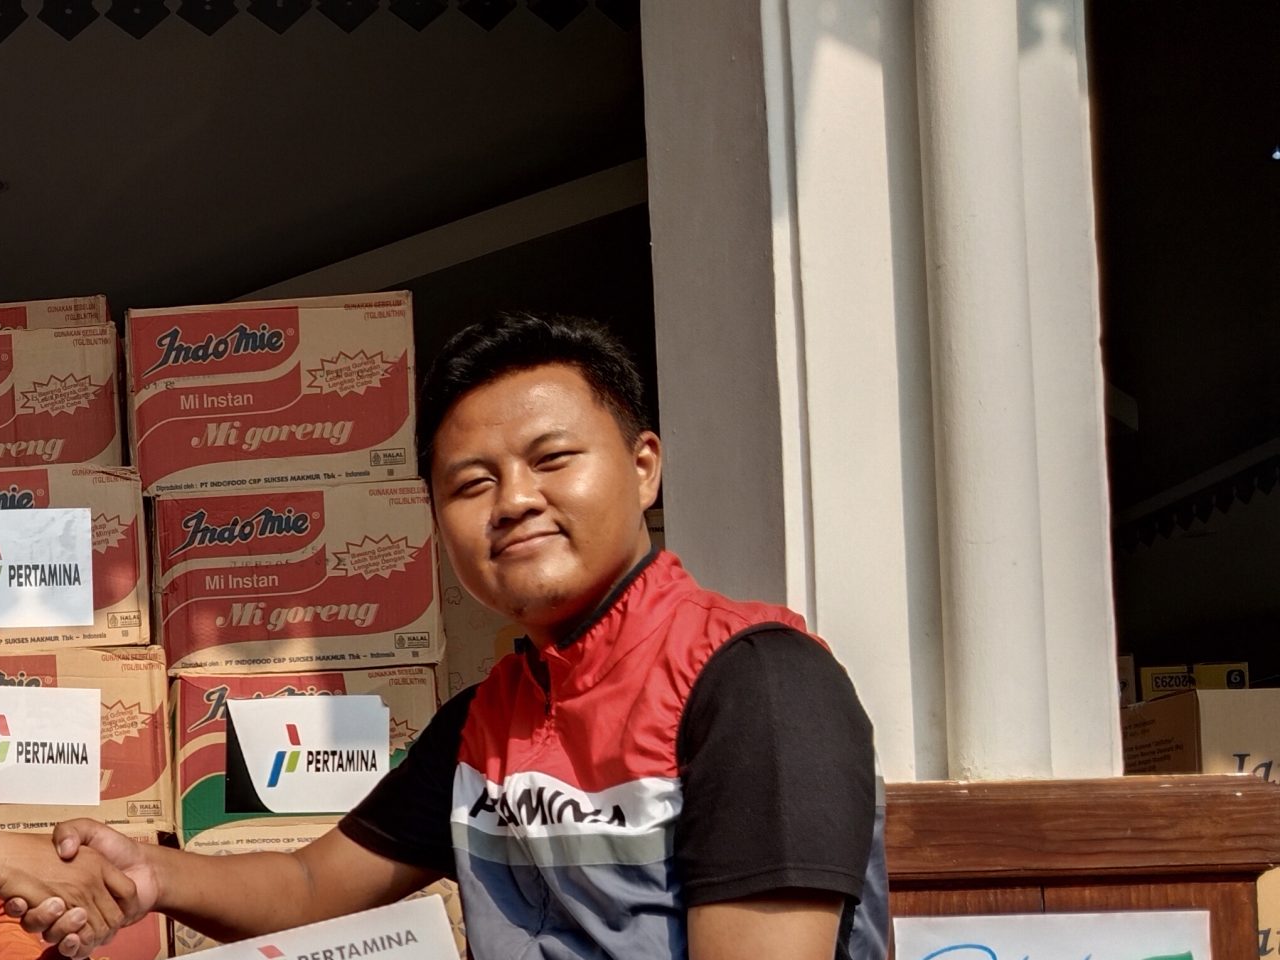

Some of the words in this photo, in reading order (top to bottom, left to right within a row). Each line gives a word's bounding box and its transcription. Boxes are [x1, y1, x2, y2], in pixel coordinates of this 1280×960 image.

[180, 394, 200, 411] Mi
[203, 392, 254, 408] Instan
[190, 421, 241, 449] Mi
[242, 418, 355, 451] goreng
[210, 479, 248, 488] INDOFOOD
[264, 476, 288, 484] SUKSES
[290, 474, 320, 482] MAKMUR
[8, 562, 81, 588] PERTAMINA
[205, 574, 225, 590] Mi
[228, 572, 278, 588] Instan
[215, 602, 266, 628] Mi
[266, 602, 380, 632] goreng
[30, 634, 60, 643] MAKMUR
[234, 658, 272, 666] INDOFOOD
[288, 656, 314, 664] SUKSES
[314, 654, 346, 662] MAKMUR
[16, 740, 88, 765] PERTAMINA
[306, 750, 378, 773] PERTAMINA
